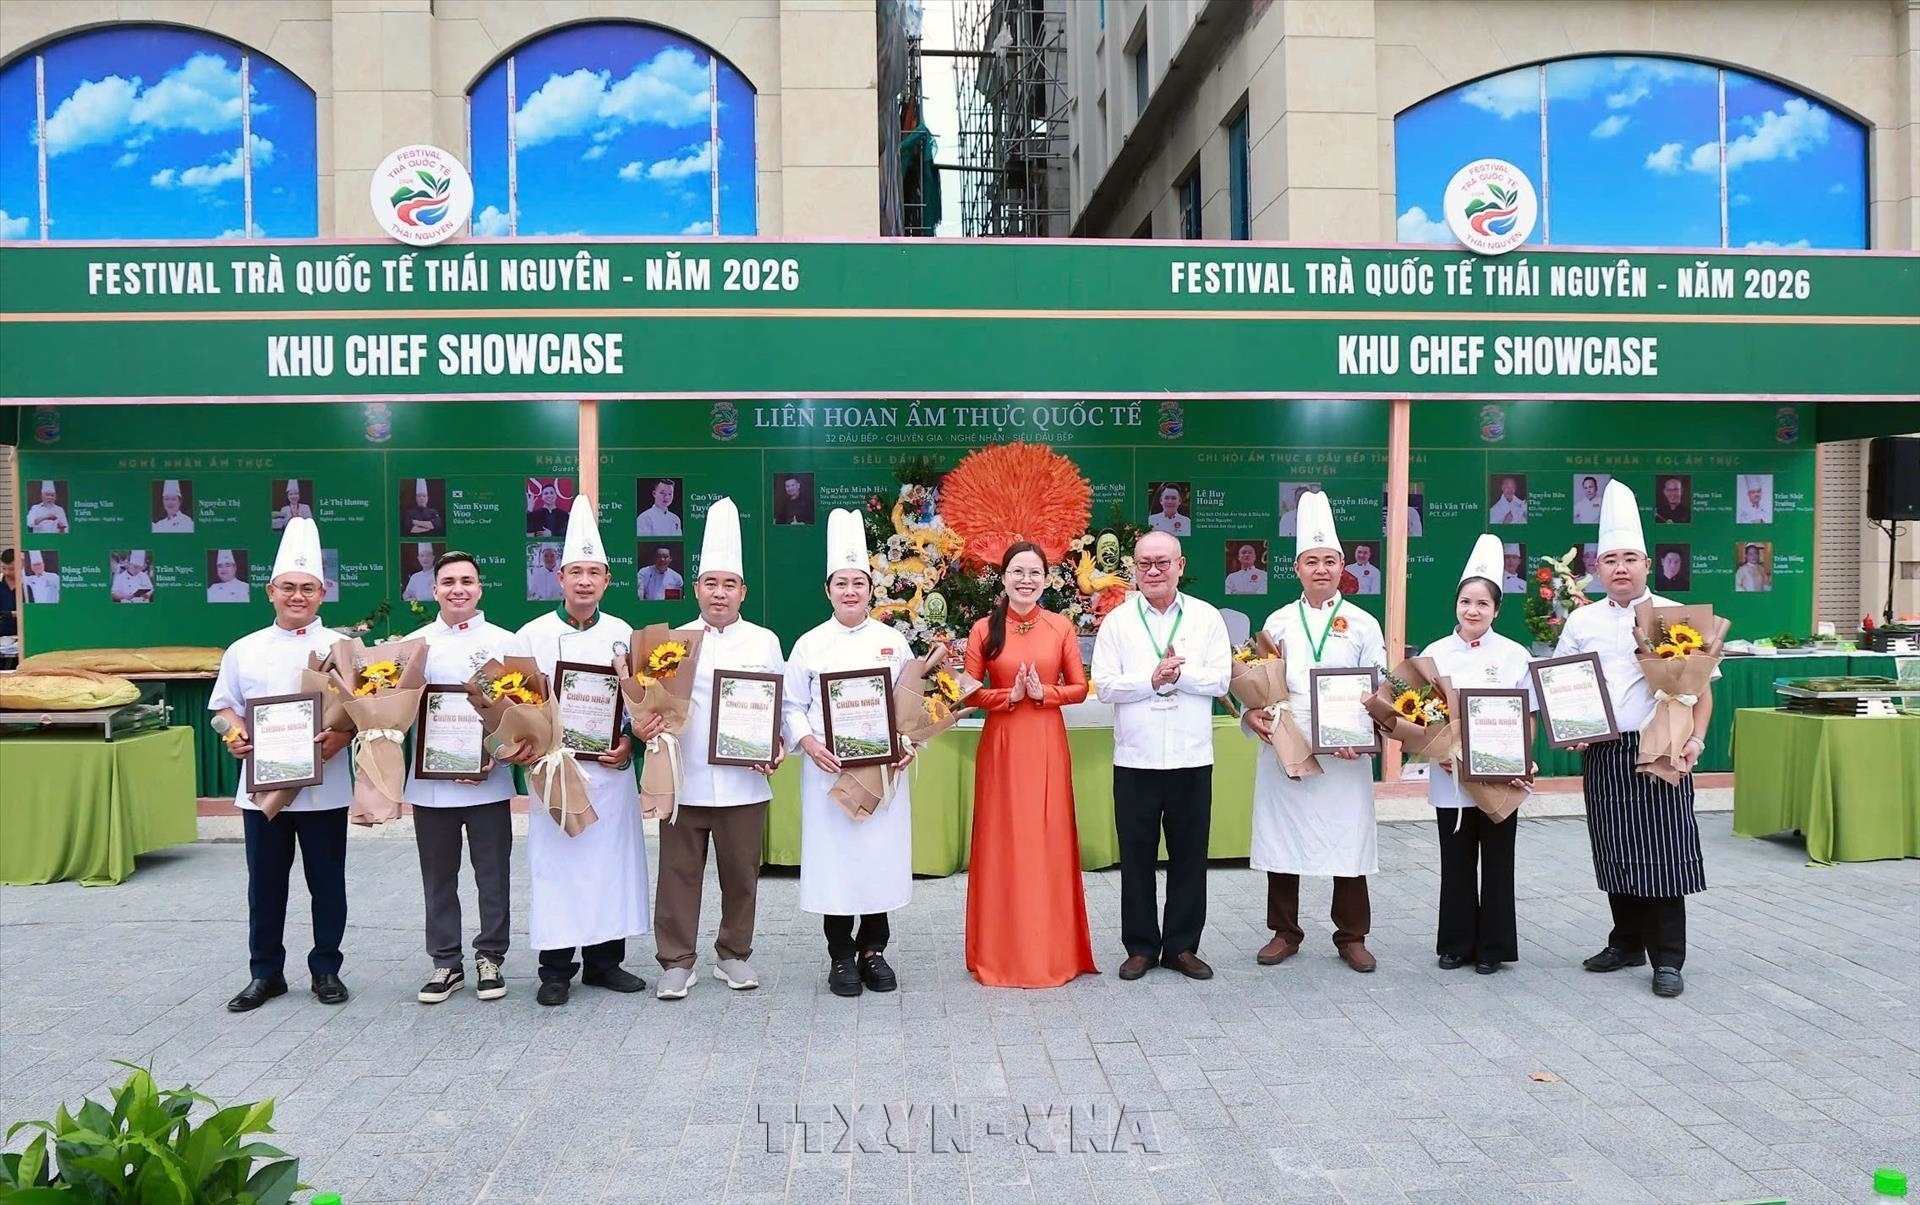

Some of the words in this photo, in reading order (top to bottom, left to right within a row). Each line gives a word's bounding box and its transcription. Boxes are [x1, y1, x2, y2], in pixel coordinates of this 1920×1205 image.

[397, 149, 442, 161] FESTIVAL
[1468, 163, 1509, 175] FESTIVAL
[88, 263, 221, 295] FESTIVAL
[231, 254, 285, 294] TRÀ
[297, 252, 372, 294] QUỐC
[382, 252, 418, 292] TẾ
[426, 252, 488, 292] THÁI
[501, 250, 610, 291] NGUYÊN
[646, 250, 710, 291] NĂM
[723, 258, 800, 291] 2026
[1170, 261, 1296, 294] FESTIVAL
[1305, 255, 1354, 294] TRÀ
[1365, 256, 1435, 296] QUỐC
[1444, 255, 1476, 295] TẾ
[1484, 258, 1540, 297] THÁI
[1550, 259, 1648, 297] NGUYÊN
[1678, 260, 1735, 298] NĂM
[1744, 268, 1810, 299] 2026
[268, 335, 334, 377] KHU
[345, 334, 428, 376] CHEF
[438, 332, 624, 376] SHOWCASE
[1338, 335, 1399, 375] KHU
[1410, 335, 1486, 375] CHEF
[1494, 336, 1658, 376] SHOWCASE
[754, 403, 815, 427] LIÊN
[823, 407, 898, 427] HOAN
[908, 401, 946, 427] ẨM
[953, 404, 1027, 432] THỰC
[1032, 402, 1105, 432] QUỐC
[1110, 400, 1142, 426] TẾ
[825, 433, 837, 442] 32
[839, 433, 859, 442] ĐẦU
[861, 432, 878, 442] BẾP
[885, 432, 923, 442] CHUYÊN
[926, 433, 943, 442] GIA
[950, 432, 976, 443] NGHỆ
[978, 433, 1005, 442] NHÂN
[1012, 433, 1033, 442] SIÊU
[1056, 432, 1074, 442] BẾP
[1197, 453, 1217, 463] CHI
[1656, 455, 1680, 467] KOL
[552, 465, 576, 473] Guest
[1290, 465, 1336, 475] NGUYÊN
[820, 485, 850, 495] Nguyễn
[851, 485, 872, 493] Minh
[1196, 490, 1207, 498] Lê
[1208, 490, 1226, 500] Huy
[690, 493, 707, 501] Cao
[1196, 496, 1225, 507] Hoàng
[1357, 497, 1379, 507] Hồng
[331, 498, 343, 509] Thị
[452, 502, 471, 511] Nam
[473, 502, 500, 513] Kyung
[611, 502, 623, 510] De
[1429, 502, 1442, 511] Bùi
[1443, 502, 1459, 511] Văn
[452, 510, 471, 518] Woo
[488, 555, 506, 564] Văn
[1274, 555, 1293, 563] Trần
[1416, 555, 1435, 563] Tiến
[369, 563, 384, 571] Văn
